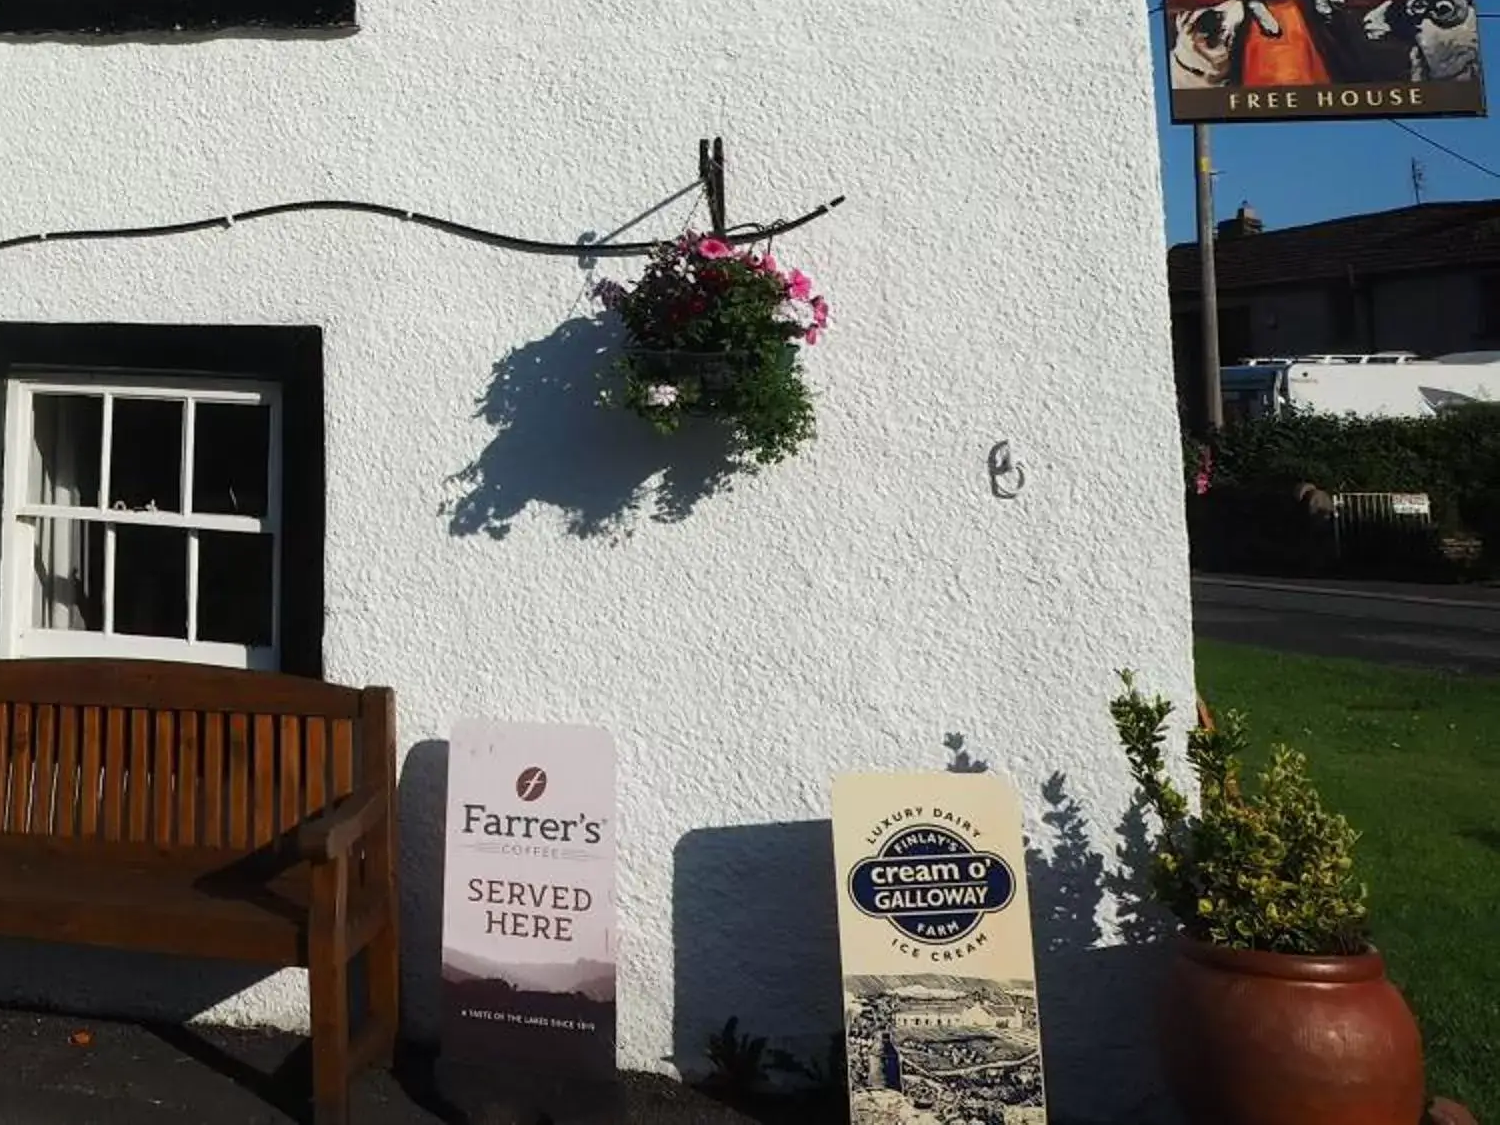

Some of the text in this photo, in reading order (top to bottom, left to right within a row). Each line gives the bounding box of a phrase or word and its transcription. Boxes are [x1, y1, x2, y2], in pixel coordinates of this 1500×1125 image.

[1229, 87, 1424, 111] FREE HOUSE
[462, 804, 601, 844] Farrer's
[866, 807, 981, 845] LUXURY DAIRY
[501, 844, 560, 860] COFFEE
[893, 832, 959, 854] FINLAY'S
[871, 858, 994, 884] cream o'
[467, 878, 592, 912] SERVED
[875, 887, 988, 910] GALLOWAY
[486, 911, 573, 942] HERE
[917, 920, 960, 936] FARM
[891, 933, 988, 962] ICE CREAM
